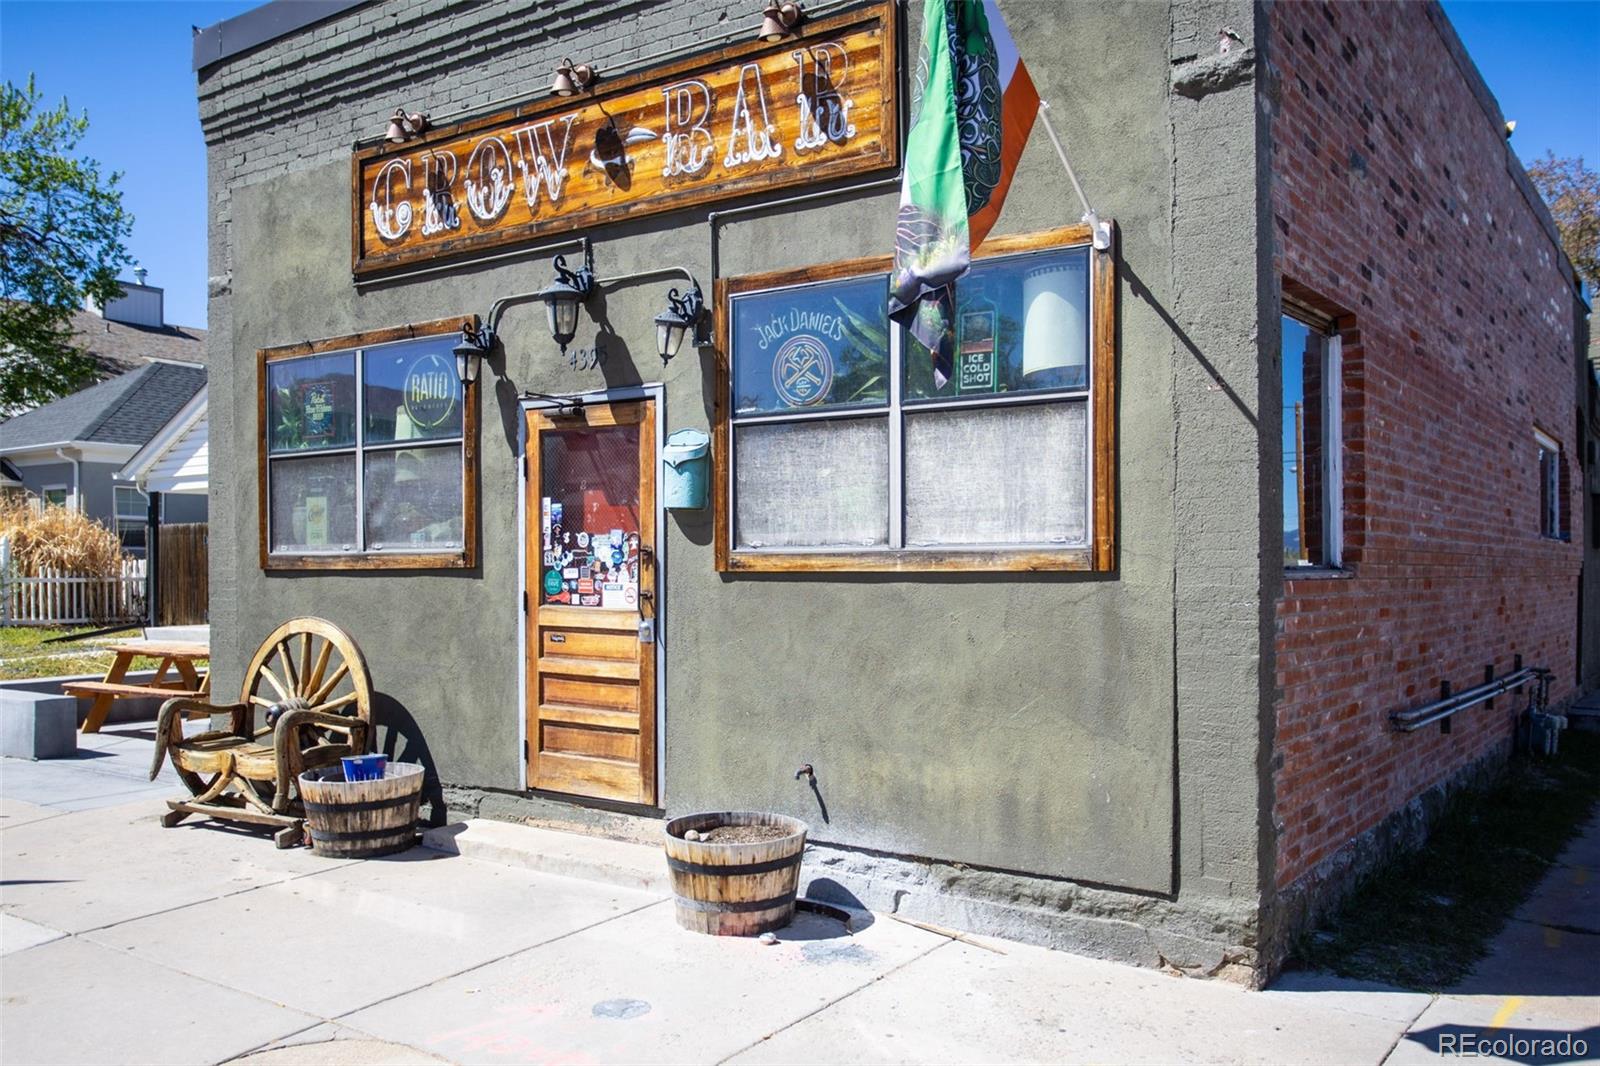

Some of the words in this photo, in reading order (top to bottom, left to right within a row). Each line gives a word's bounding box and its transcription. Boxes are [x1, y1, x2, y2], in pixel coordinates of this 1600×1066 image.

[369, 112, 579, 241] CROW
[661, 41, 857, 179] BAR
[756, 314, 790, 350] JACK
[963, 363, 991, 374] COLD
[968, 353, 985, 363] ICE
[411, 371, 448, 403] RATIO
[963, 372, 991, 384] SHOT
